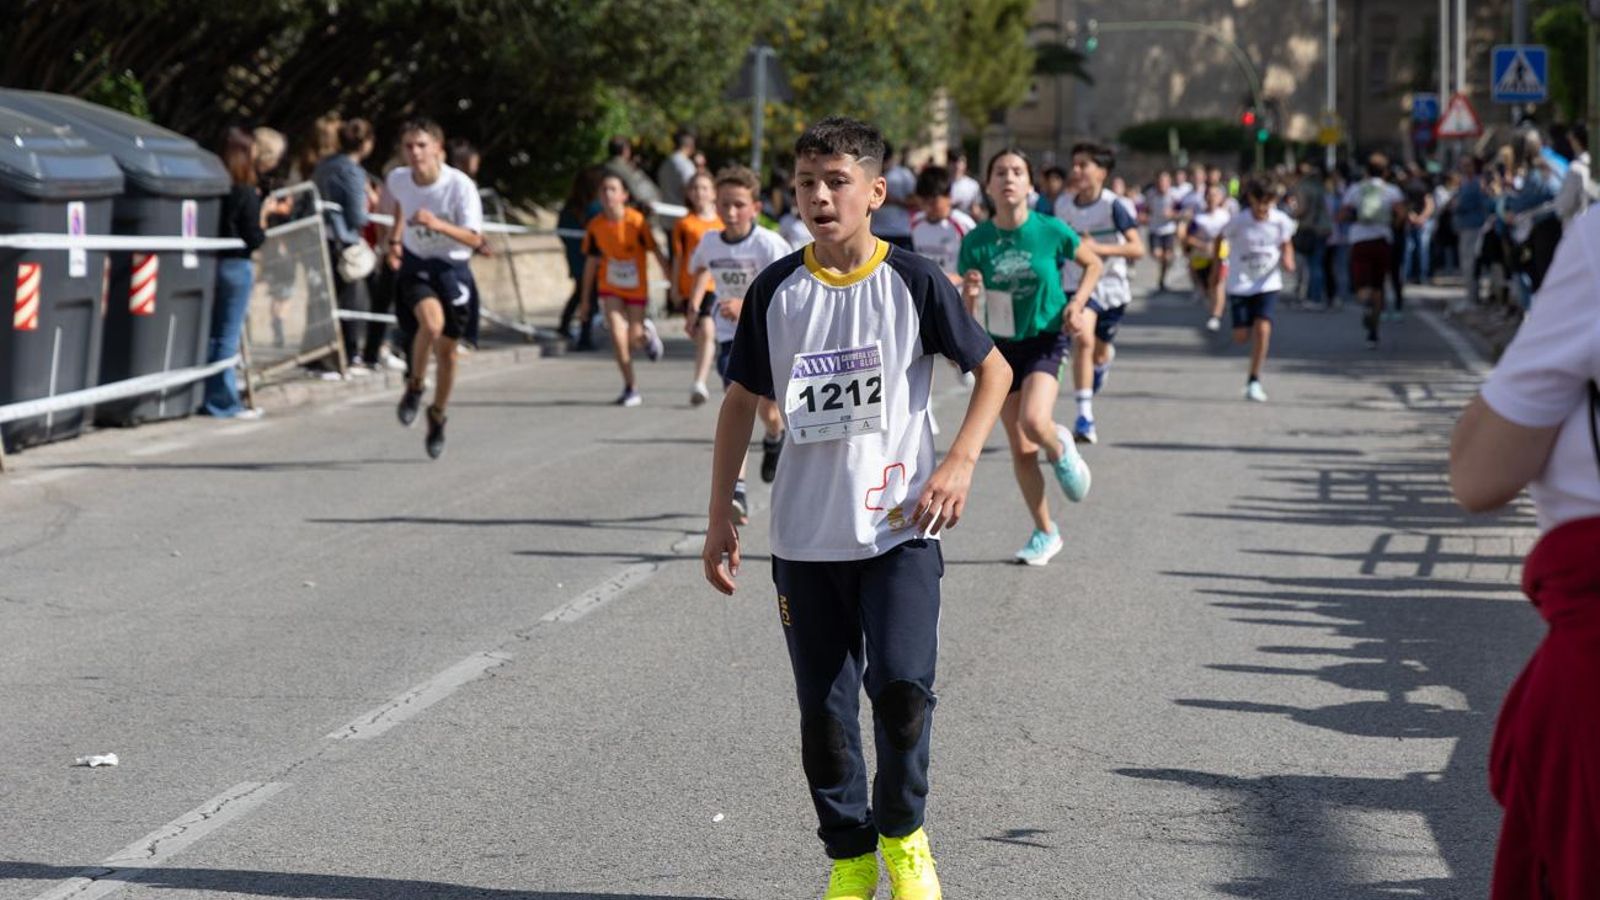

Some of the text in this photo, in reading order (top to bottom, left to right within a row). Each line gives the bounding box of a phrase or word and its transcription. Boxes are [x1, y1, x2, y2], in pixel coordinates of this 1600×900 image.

[721, 271, 747, 285] 607
[846, 360, 855, 370] LA
[799, 375, 881, 413] 1212
[779, 594, 791, 626] MCI
